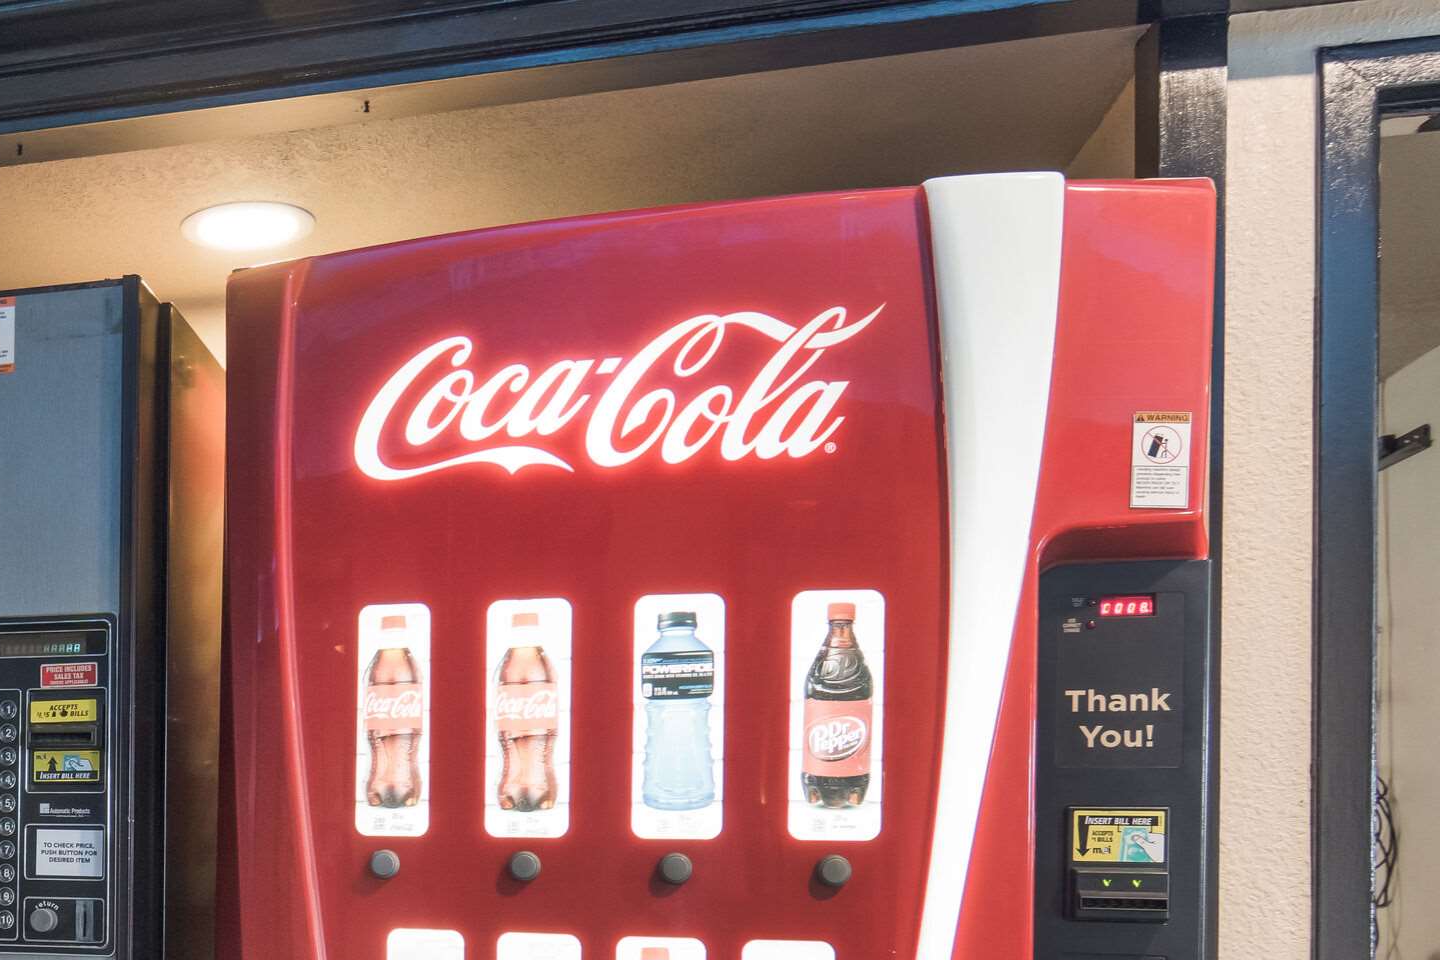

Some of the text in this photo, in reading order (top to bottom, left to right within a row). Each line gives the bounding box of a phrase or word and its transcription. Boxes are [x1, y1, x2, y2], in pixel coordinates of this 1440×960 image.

[354, 302, 886, 480] Coca-Cola
[1146, 414, 1188, 422] WARNING
[1064, 687, 1172, 713] Thank
[49, 703, 78, 711] ACCEPTS
[827, 720, 849, 737] Dr
[812, 725, 861, 753] Pepper
[1079, 724, 1156, 749] You!
[40, 771, 60, 780] INSERT
[1084, 816, 1152, 825] INSERT BILL HERE
[35, 901, 59, 911] return
